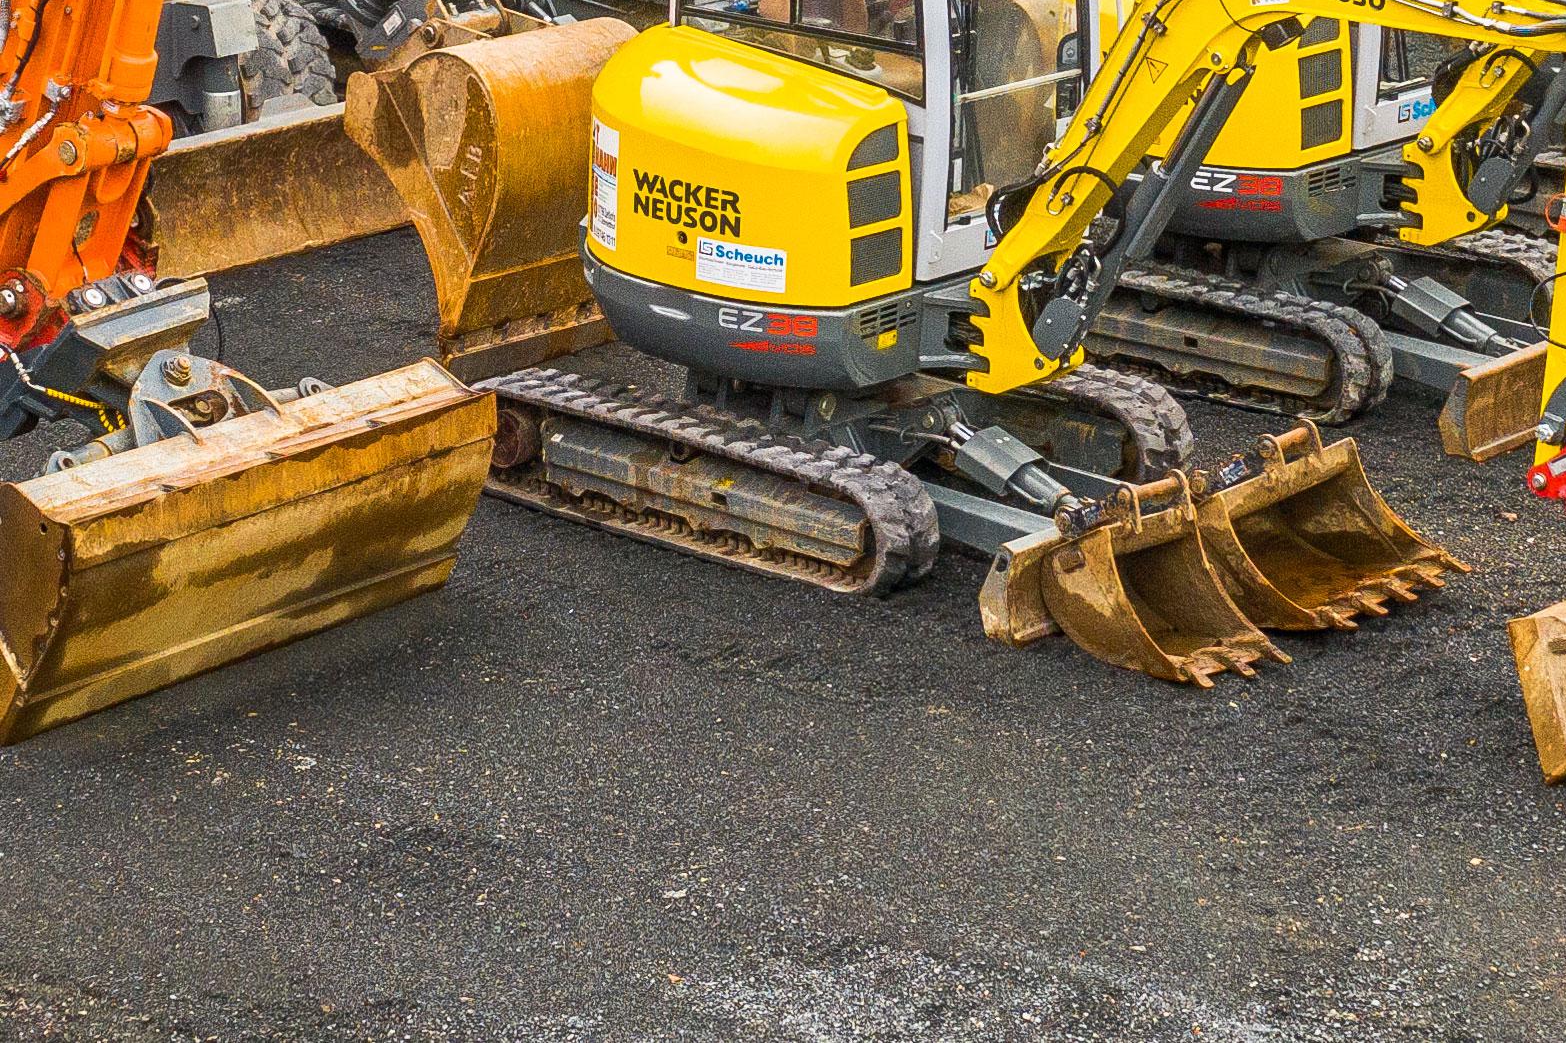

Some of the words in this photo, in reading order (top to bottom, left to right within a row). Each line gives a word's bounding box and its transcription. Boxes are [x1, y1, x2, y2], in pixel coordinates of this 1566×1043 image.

[633, 168, 741, 214] WACKER
[633, 192, 741, 238] NEUSON
[716, 245, 784, 266] Scheuch
[718, 307, 818, 337] EZ38
